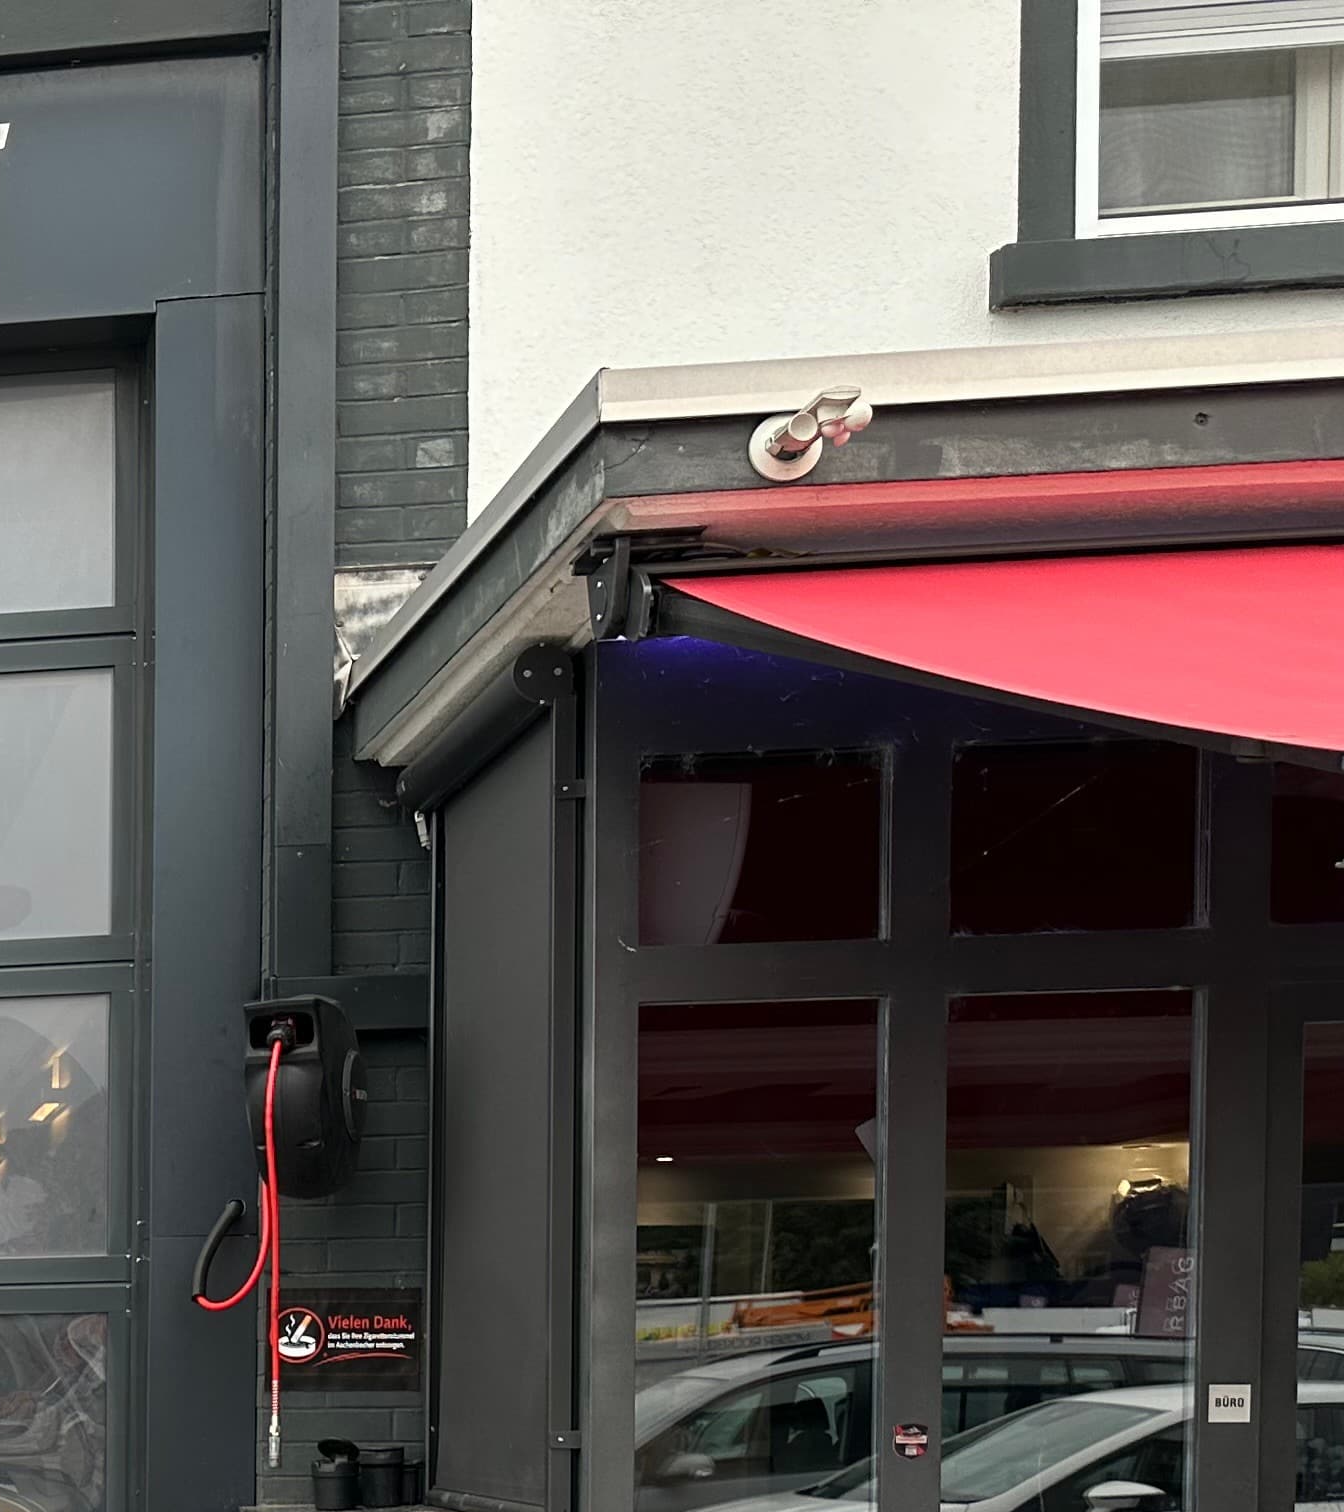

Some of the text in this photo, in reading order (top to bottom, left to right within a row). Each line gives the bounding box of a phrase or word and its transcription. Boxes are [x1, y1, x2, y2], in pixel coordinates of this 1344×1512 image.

[327, 1315, 412, 1331] Vielen Dank,
[1214, 1396, 1245, 1408] BÜRO
